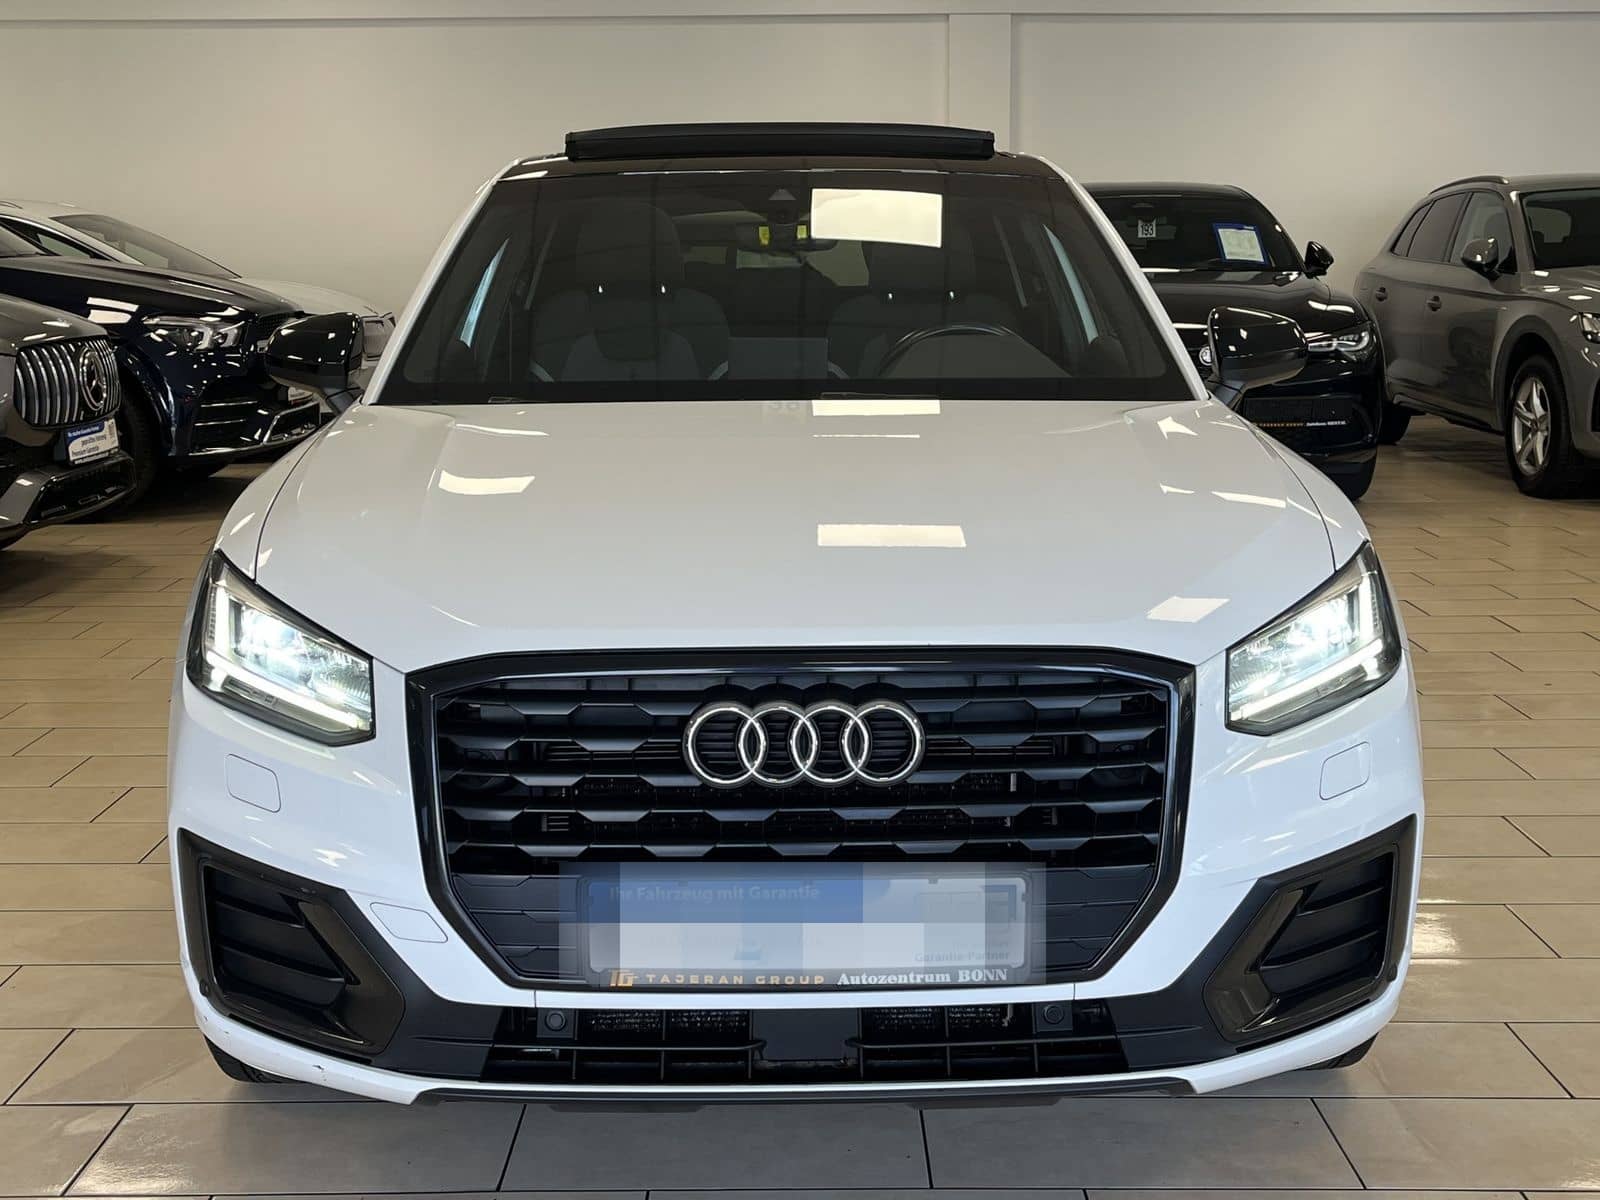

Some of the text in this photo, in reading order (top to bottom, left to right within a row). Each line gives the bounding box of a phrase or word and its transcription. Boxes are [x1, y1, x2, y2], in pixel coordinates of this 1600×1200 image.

[637, 886, 713, 904] Fahrzeug
[717, 886, 745, 899] mit
[750, 885, 820, 899] Garantie
[646, 973, 744, 985] TAJERAN
[755, 975, 825, 986] GROUP
[837, 970, 951, 986] Autozentrum
[958, 968, 1009, 983] BONN
